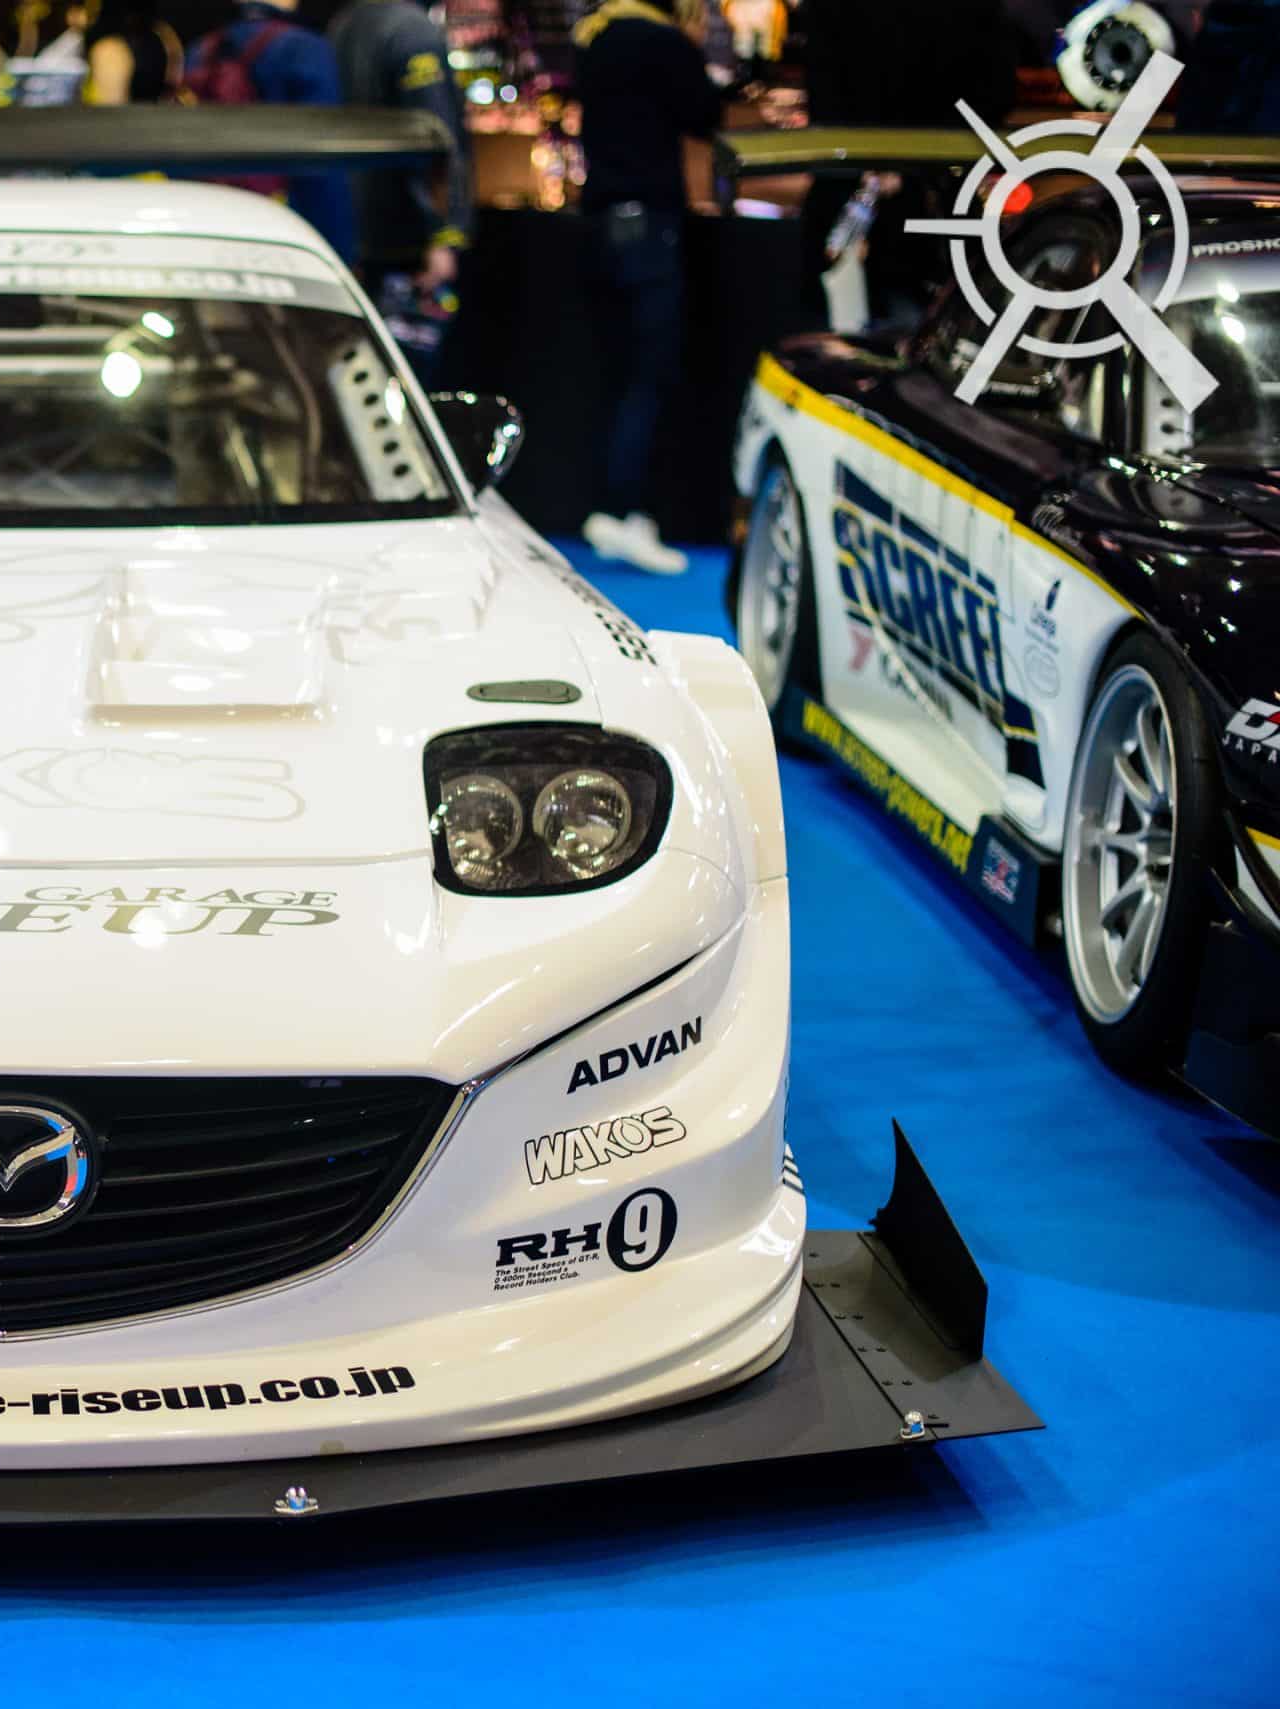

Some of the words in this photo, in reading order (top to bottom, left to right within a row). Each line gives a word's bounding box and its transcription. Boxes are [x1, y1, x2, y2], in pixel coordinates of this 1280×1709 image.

[24, 886, 339, 908] GARAGE
[566, 1016, 703, 1095] ADVAN
[495, 1269, 511, 1278] The
[513, 1264, 539, 1274] Street
[493, 1280, 524, 1291] Record
[525, 1275, 558, 1286] Holders
